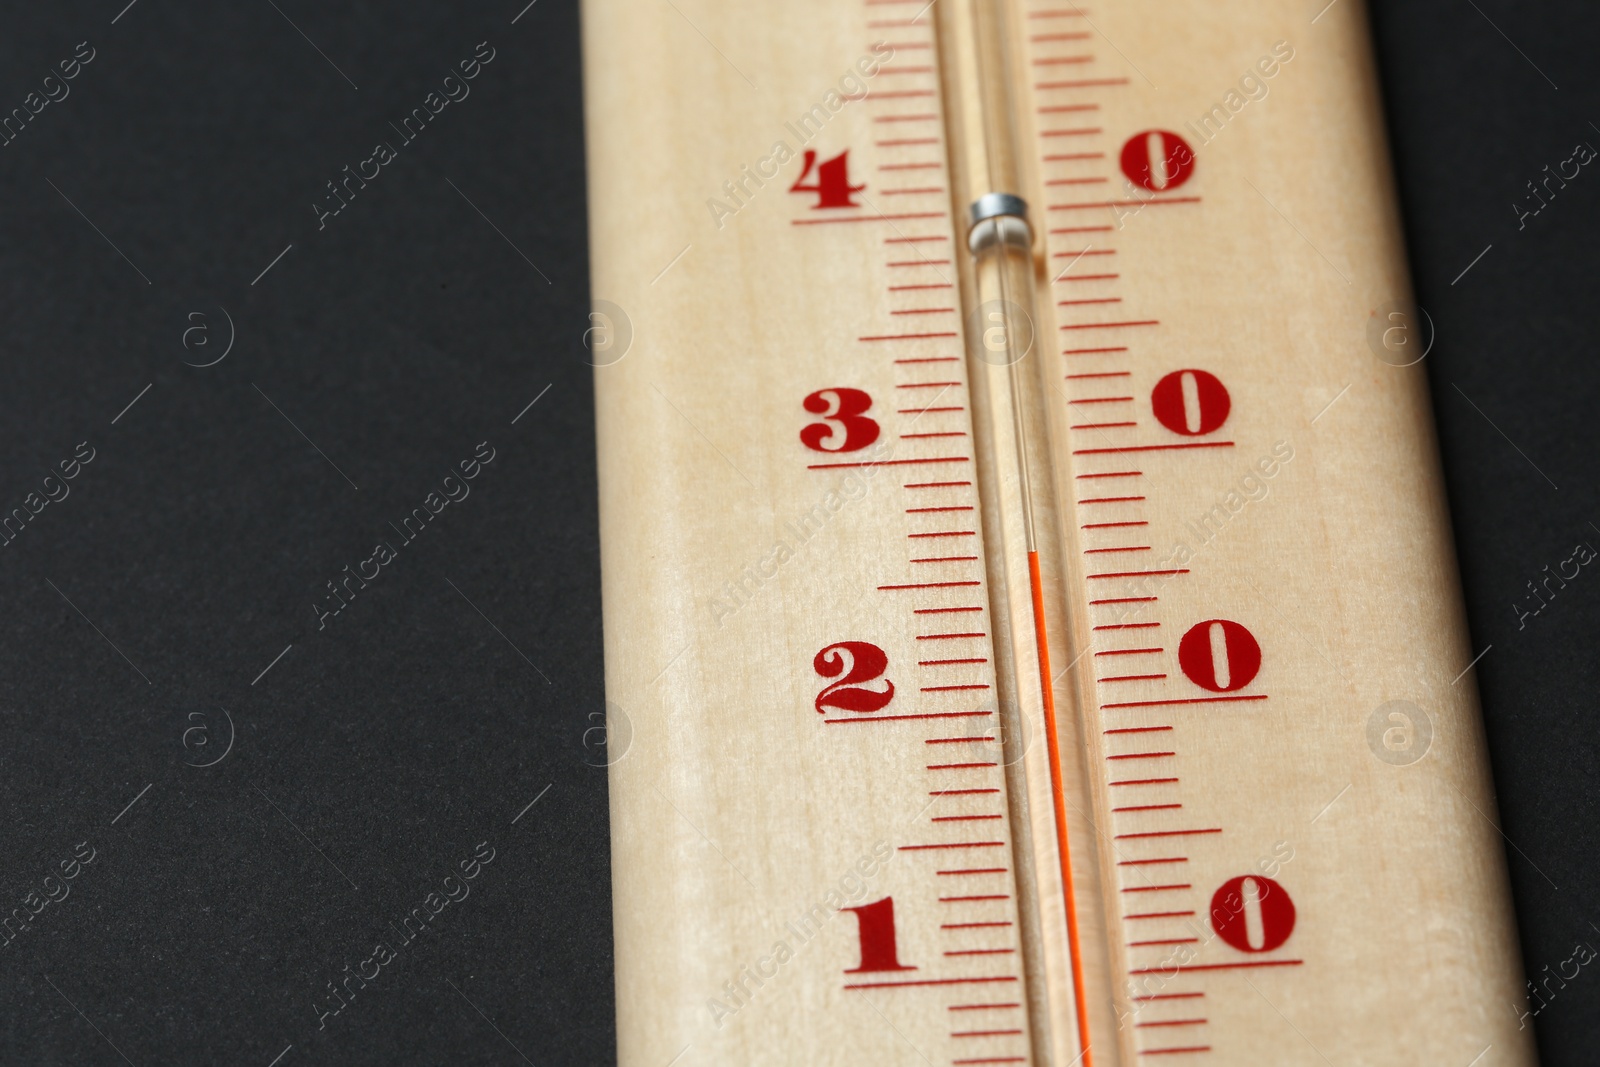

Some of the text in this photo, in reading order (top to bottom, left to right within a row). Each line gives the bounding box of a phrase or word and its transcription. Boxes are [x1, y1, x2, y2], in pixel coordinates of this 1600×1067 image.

[789, 129, 1197, 210] 4 0
[799, 368, 1232, 455] 3 0
[813, 618, 1263, 715] 2 0
[841, 874, 1297, 975] 1 0
